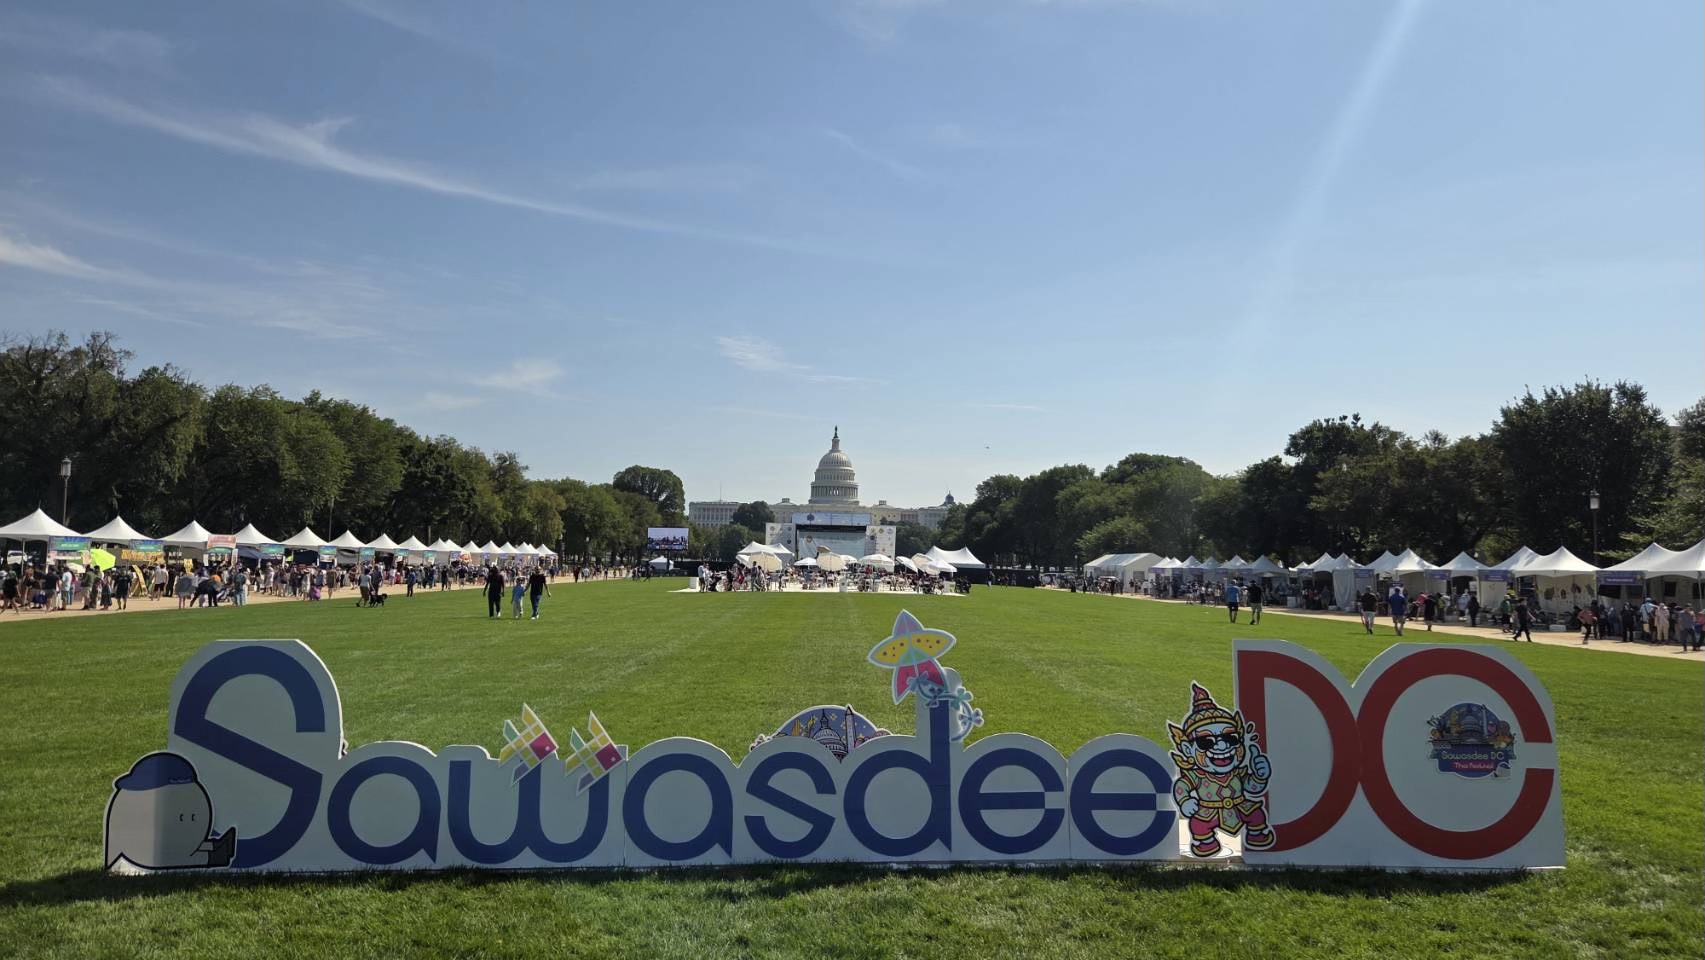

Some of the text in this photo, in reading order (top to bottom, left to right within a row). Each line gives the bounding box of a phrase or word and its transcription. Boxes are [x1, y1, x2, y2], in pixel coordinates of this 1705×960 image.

[174, 645, 1555, 868] Sawasdee DC
[1441, 750, 1504, 760] Sawasdee DC
